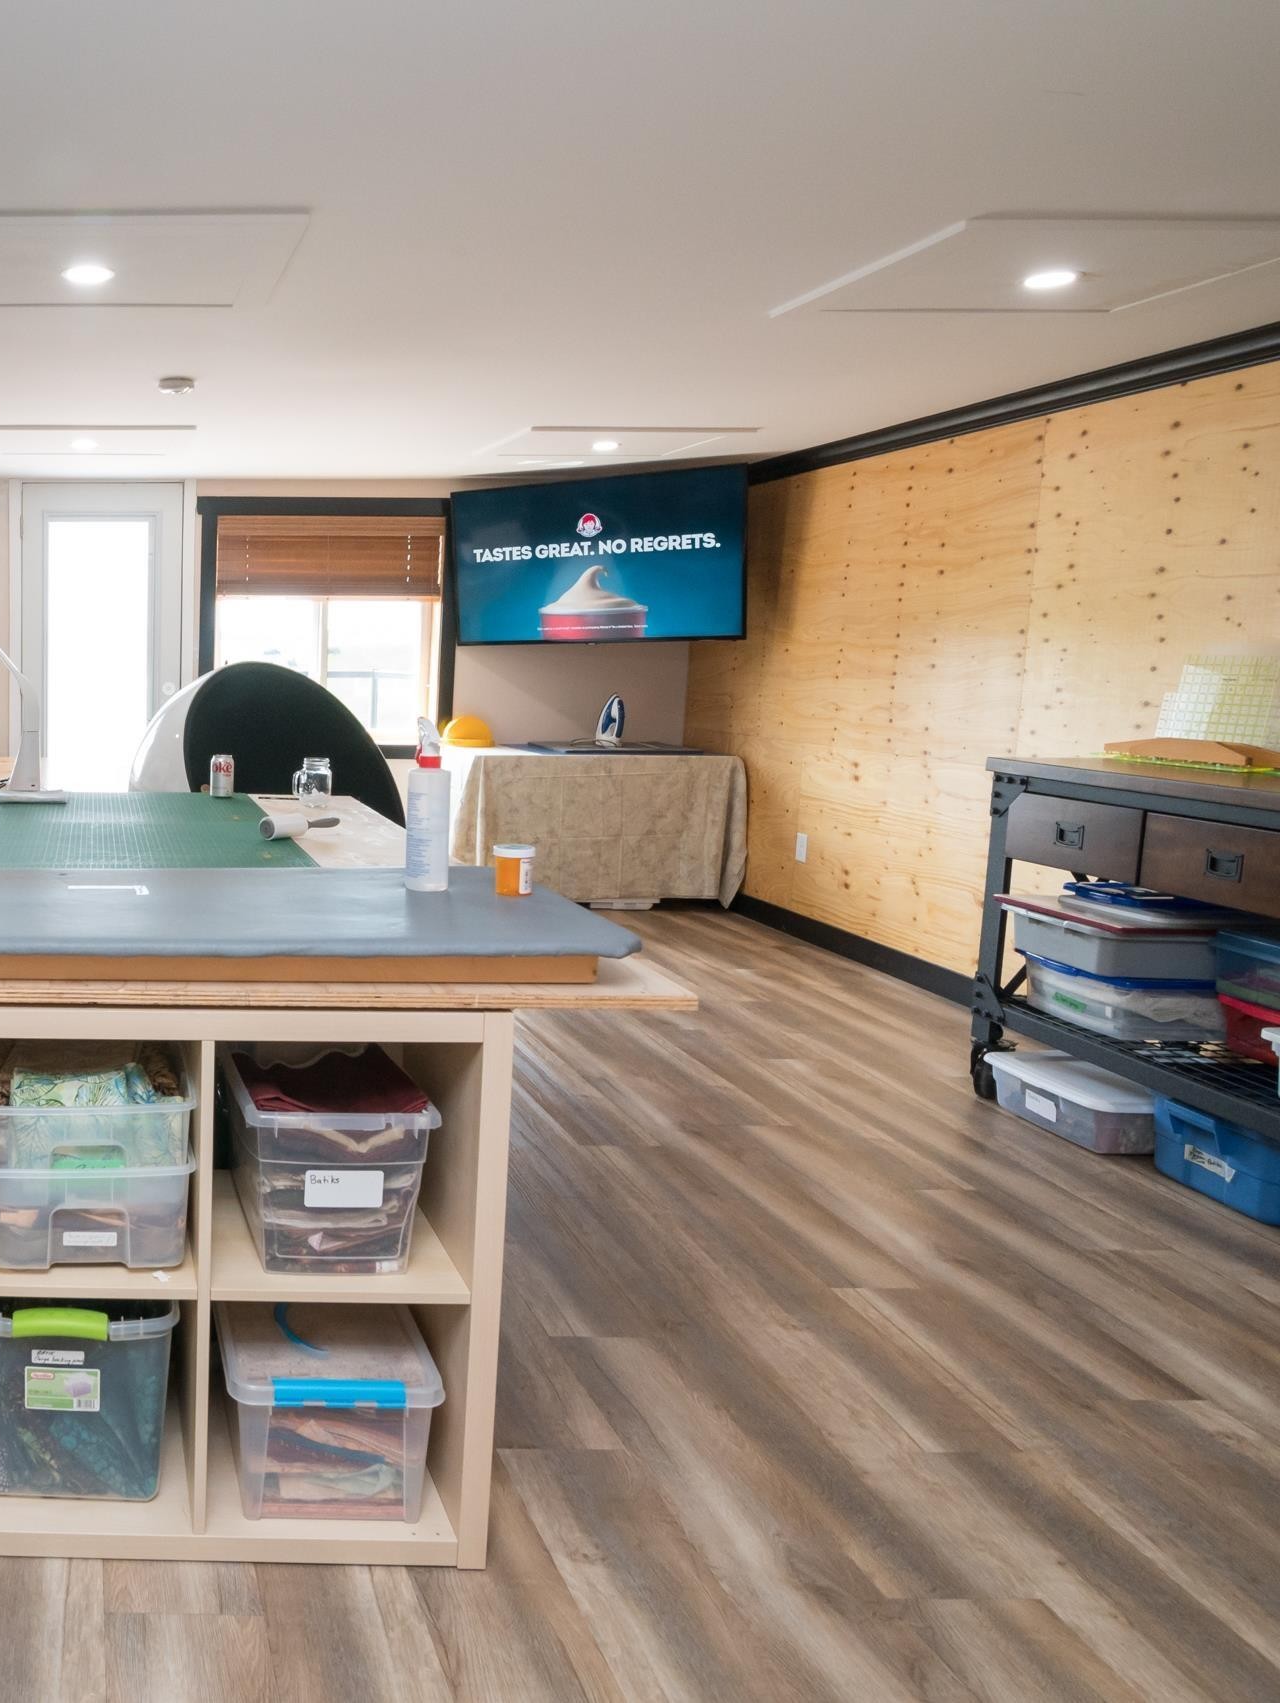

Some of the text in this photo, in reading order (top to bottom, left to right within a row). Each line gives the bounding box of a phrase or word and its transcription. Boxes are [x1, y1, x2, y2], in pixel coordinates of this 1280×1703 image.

[473, 532, 722, 563] TASTES GREAT. NO REGRETS.
[310, 1174, 340, 1185] Batiks
